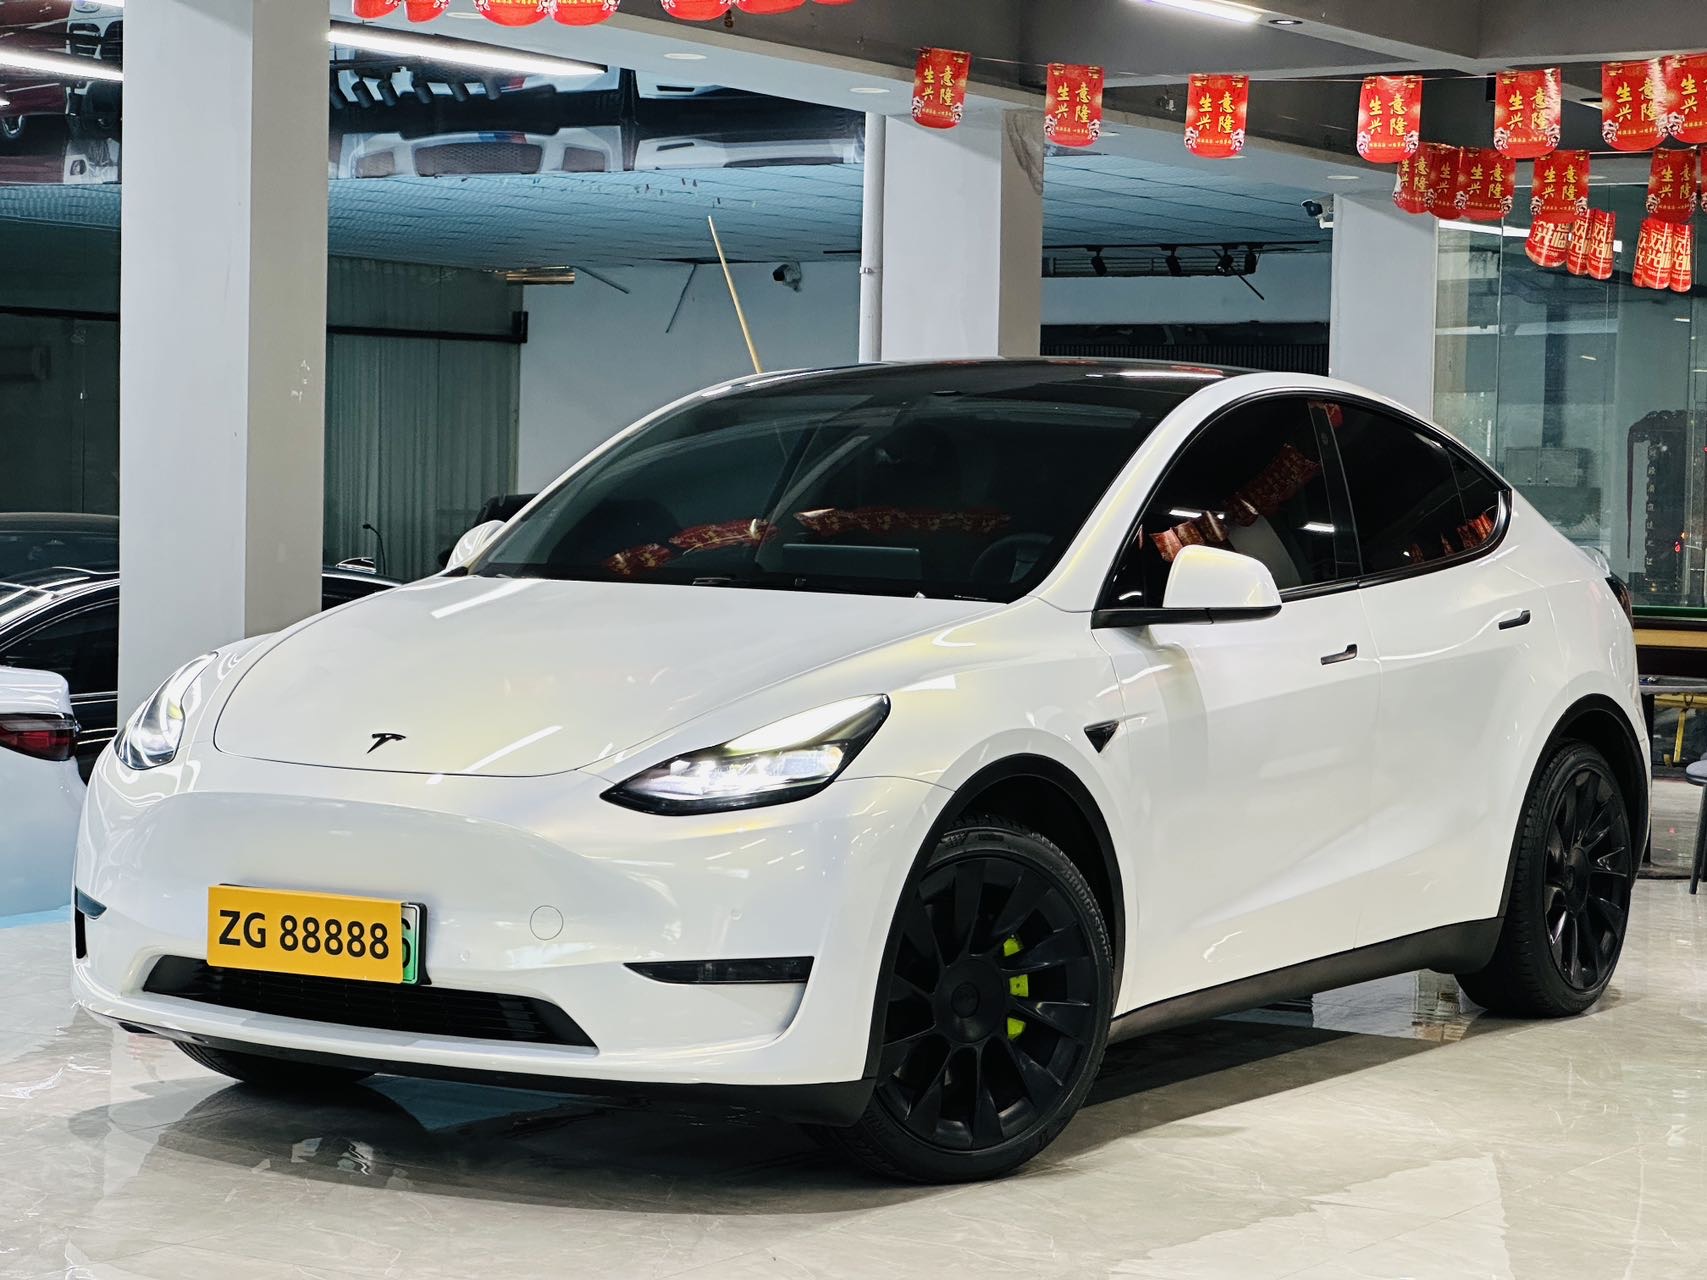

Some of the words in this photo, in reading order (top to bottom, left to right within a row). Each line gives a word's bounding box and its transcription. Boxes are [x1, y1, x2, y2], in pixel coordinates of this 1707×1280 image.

[923, 65, 956, 87] 生意
[921, 86, 955, 106] 兴隆
[1057, 82, 1091, 103] 生意
[1199, 91, 1236, 113] 生意
[1508, 86, 1548, 111] 生意
[1055, 103, 1091, 123] 兴隆
[1368, 93, 1408, 115] 生意
[1196, 114, 1236, 134] 兴隆
[1367, 117, 1408, 136] 兴隆
[1506, 111, 1549, 131] 兴隆
[1470, 163, 1505, 182] 生意
[1543, 164, 1577, 184] 生意
[1660, 163, 1691, 182] 生意
[1467, 182, 1504, 200] 兴隆
[1541, 184, 1577, 202] 兴隆
[1658, 182, 1692, 200] 兴隆
[219, 909, 267, 949] ZG
[279, 915, 389, 960] 88888
